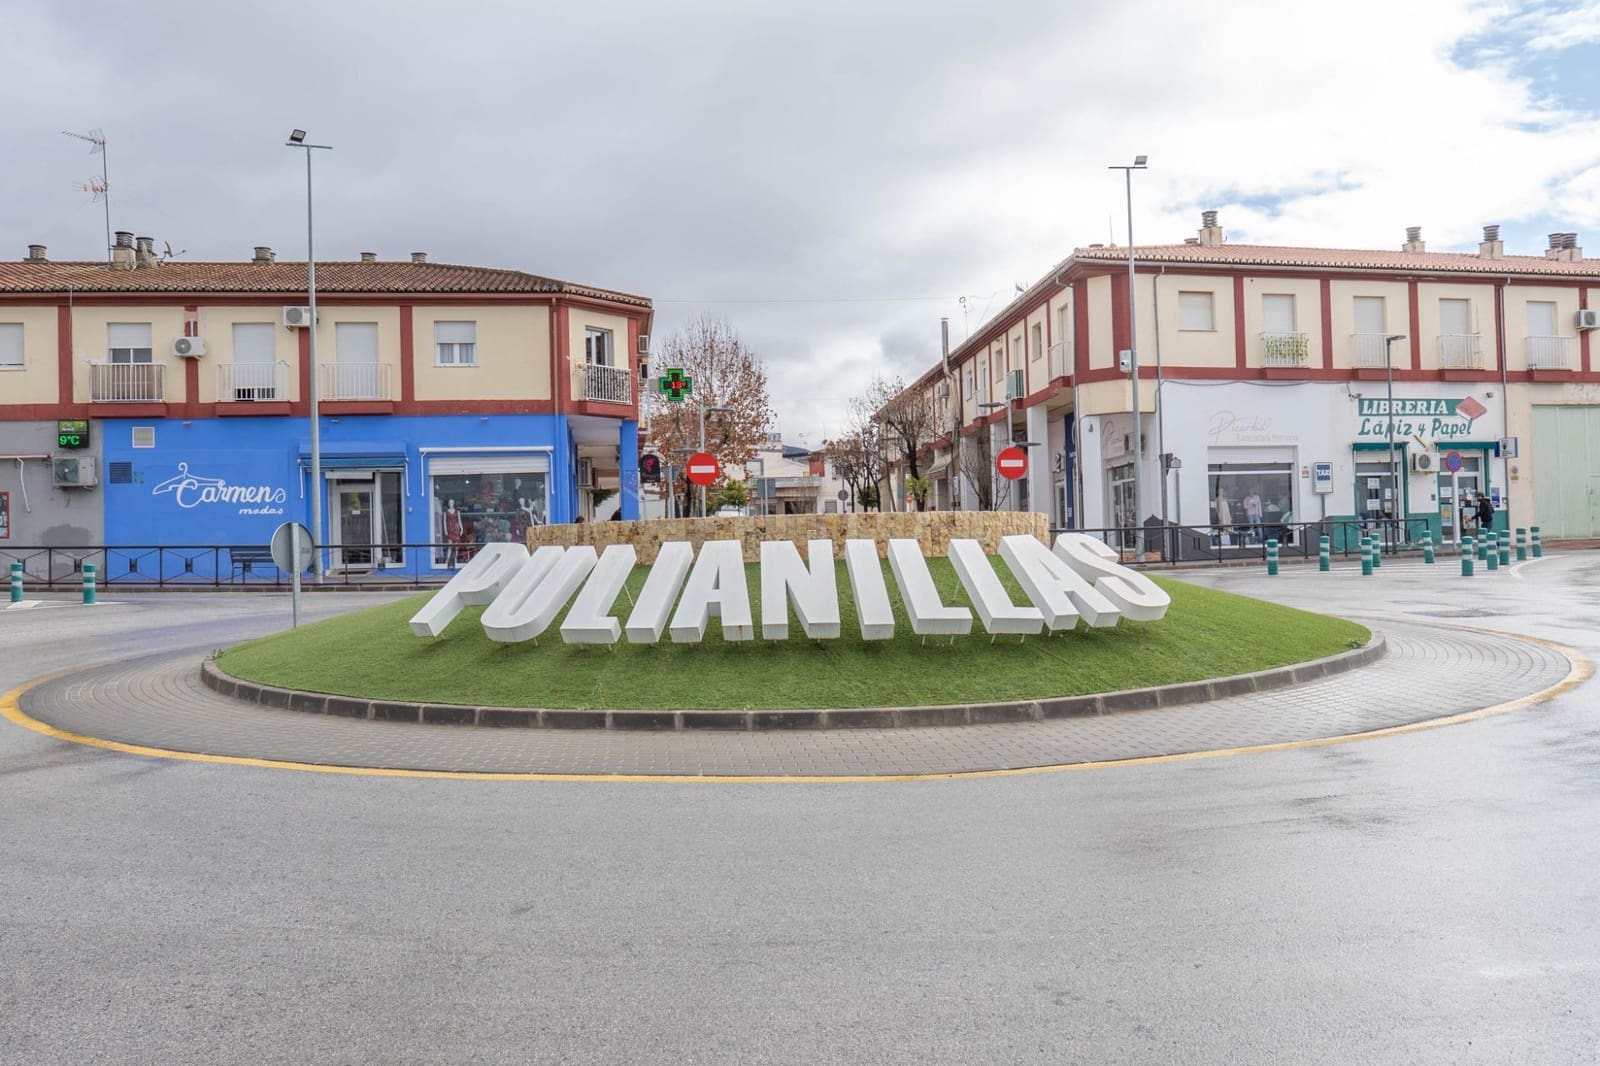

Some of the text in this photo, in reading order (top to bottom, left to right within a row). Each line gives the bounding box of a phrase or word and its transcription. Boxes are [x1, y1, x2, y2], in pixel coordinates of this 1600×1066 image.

[1361, 399, 1449, 415] LIBRERIA
[1357, 417, 1473, 440] Lápiz y Papel
[59, 435, 80, 446] 9°C
[238, 505, 284, 515] modas
[408, 532, 1170, 645] PULIANILLAS
